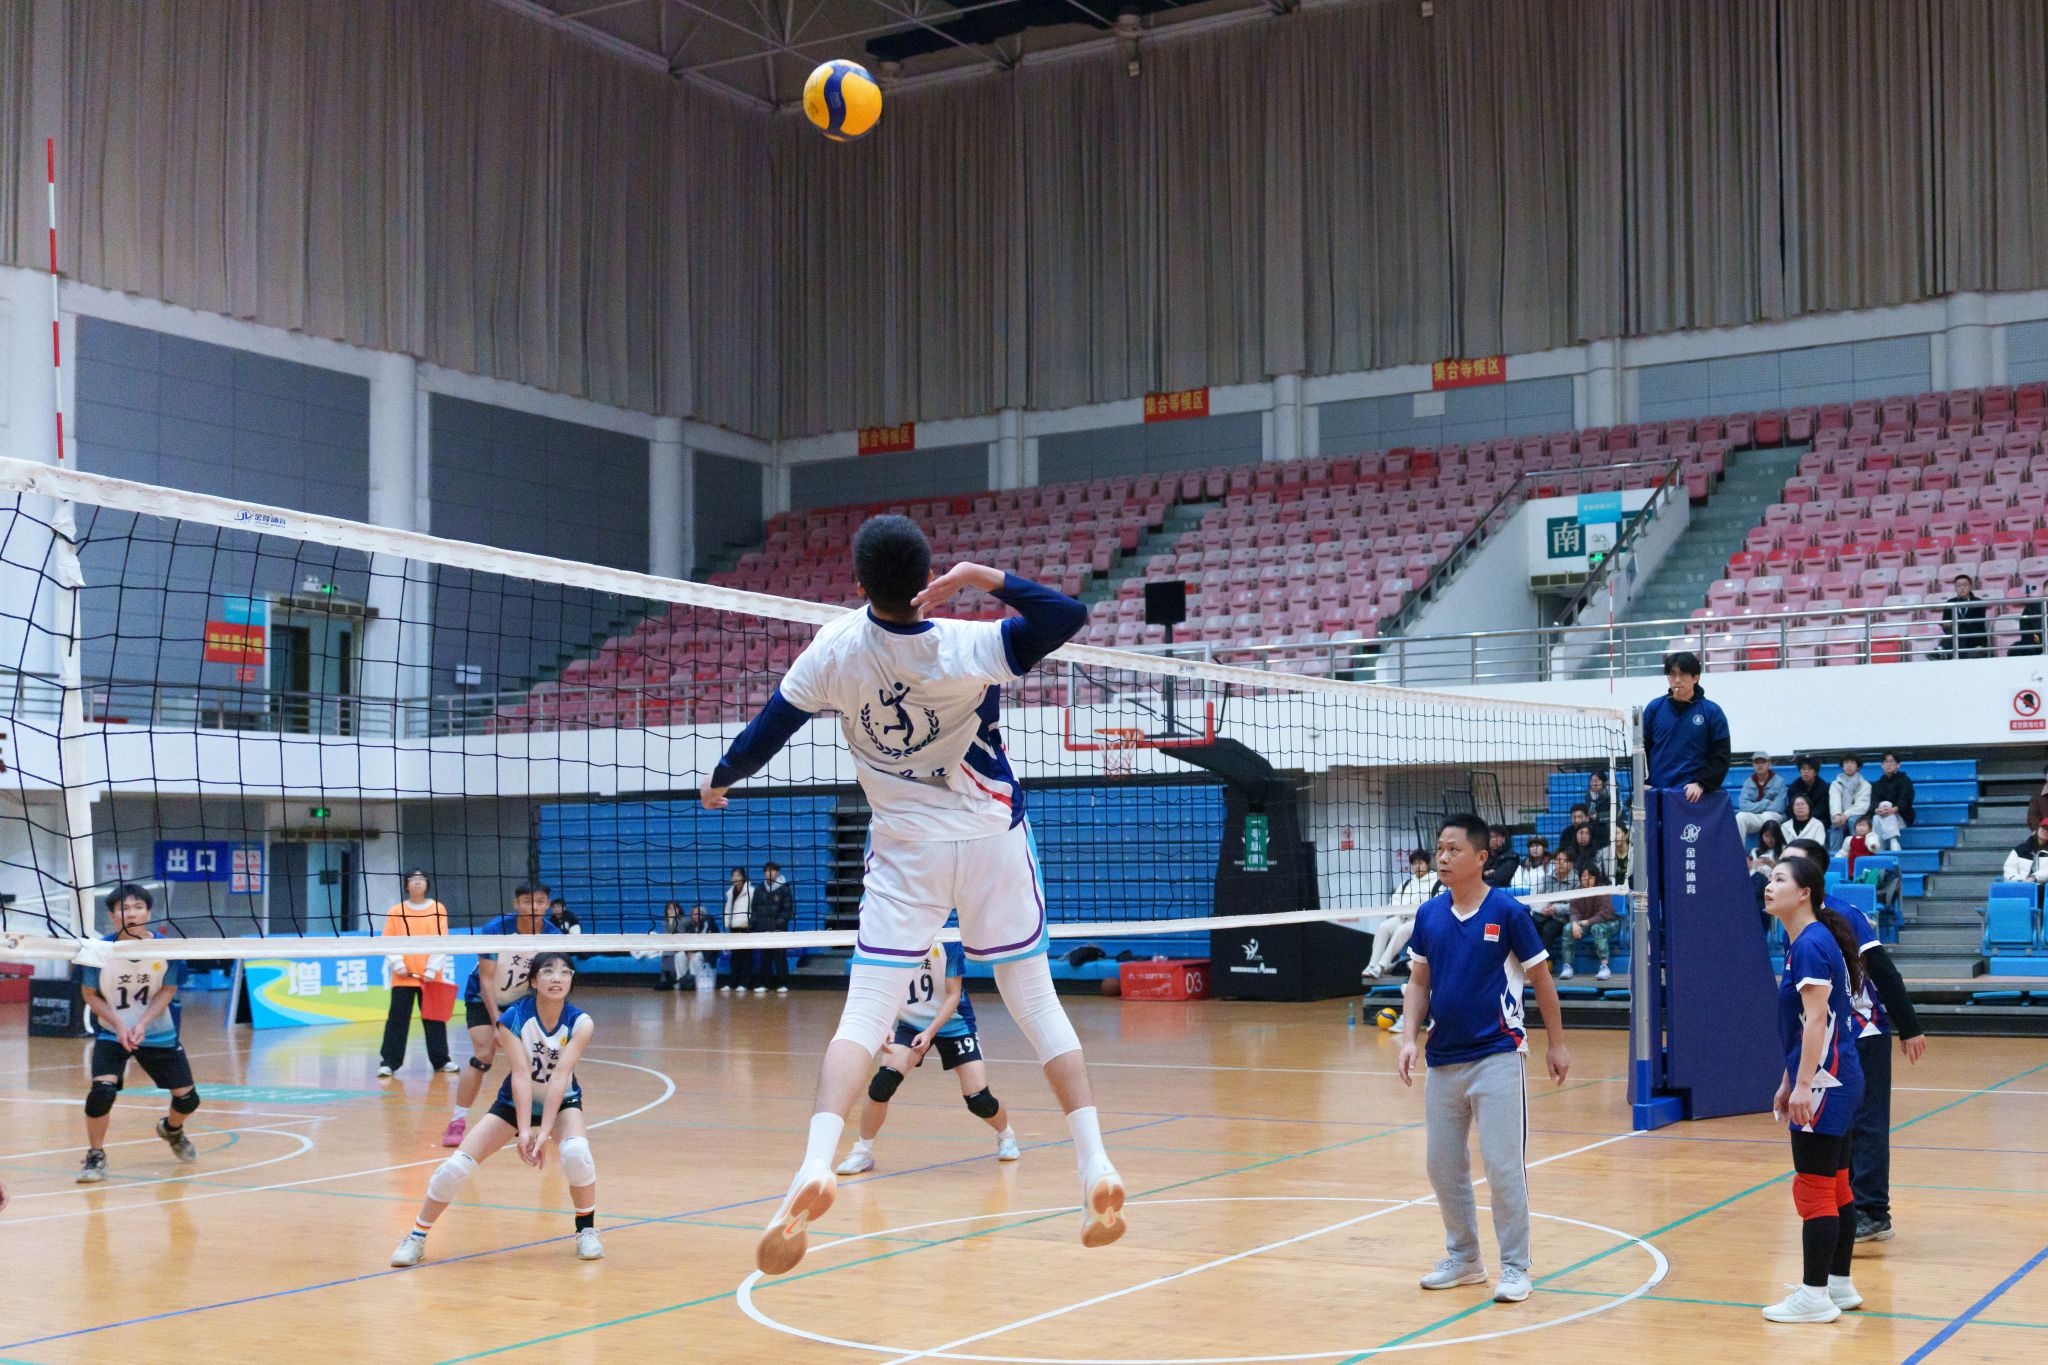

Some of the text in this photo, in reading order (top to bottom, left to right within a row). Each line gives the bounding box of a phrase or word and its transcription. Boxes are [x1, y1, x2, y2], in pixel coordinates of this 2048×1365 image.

[1552, 521, 1580, 554] 南
[167, 848, 216, 873] 出口
[118, 973, 150, 984] 文法
[907, 973, 934, 1005] 19
[1185, 971, 1203, 994] 03
[116, 985, 150, 1010] 14
[532, 1041, 559, 1060] 文法
[955, 1037, 975, 1055] 19
